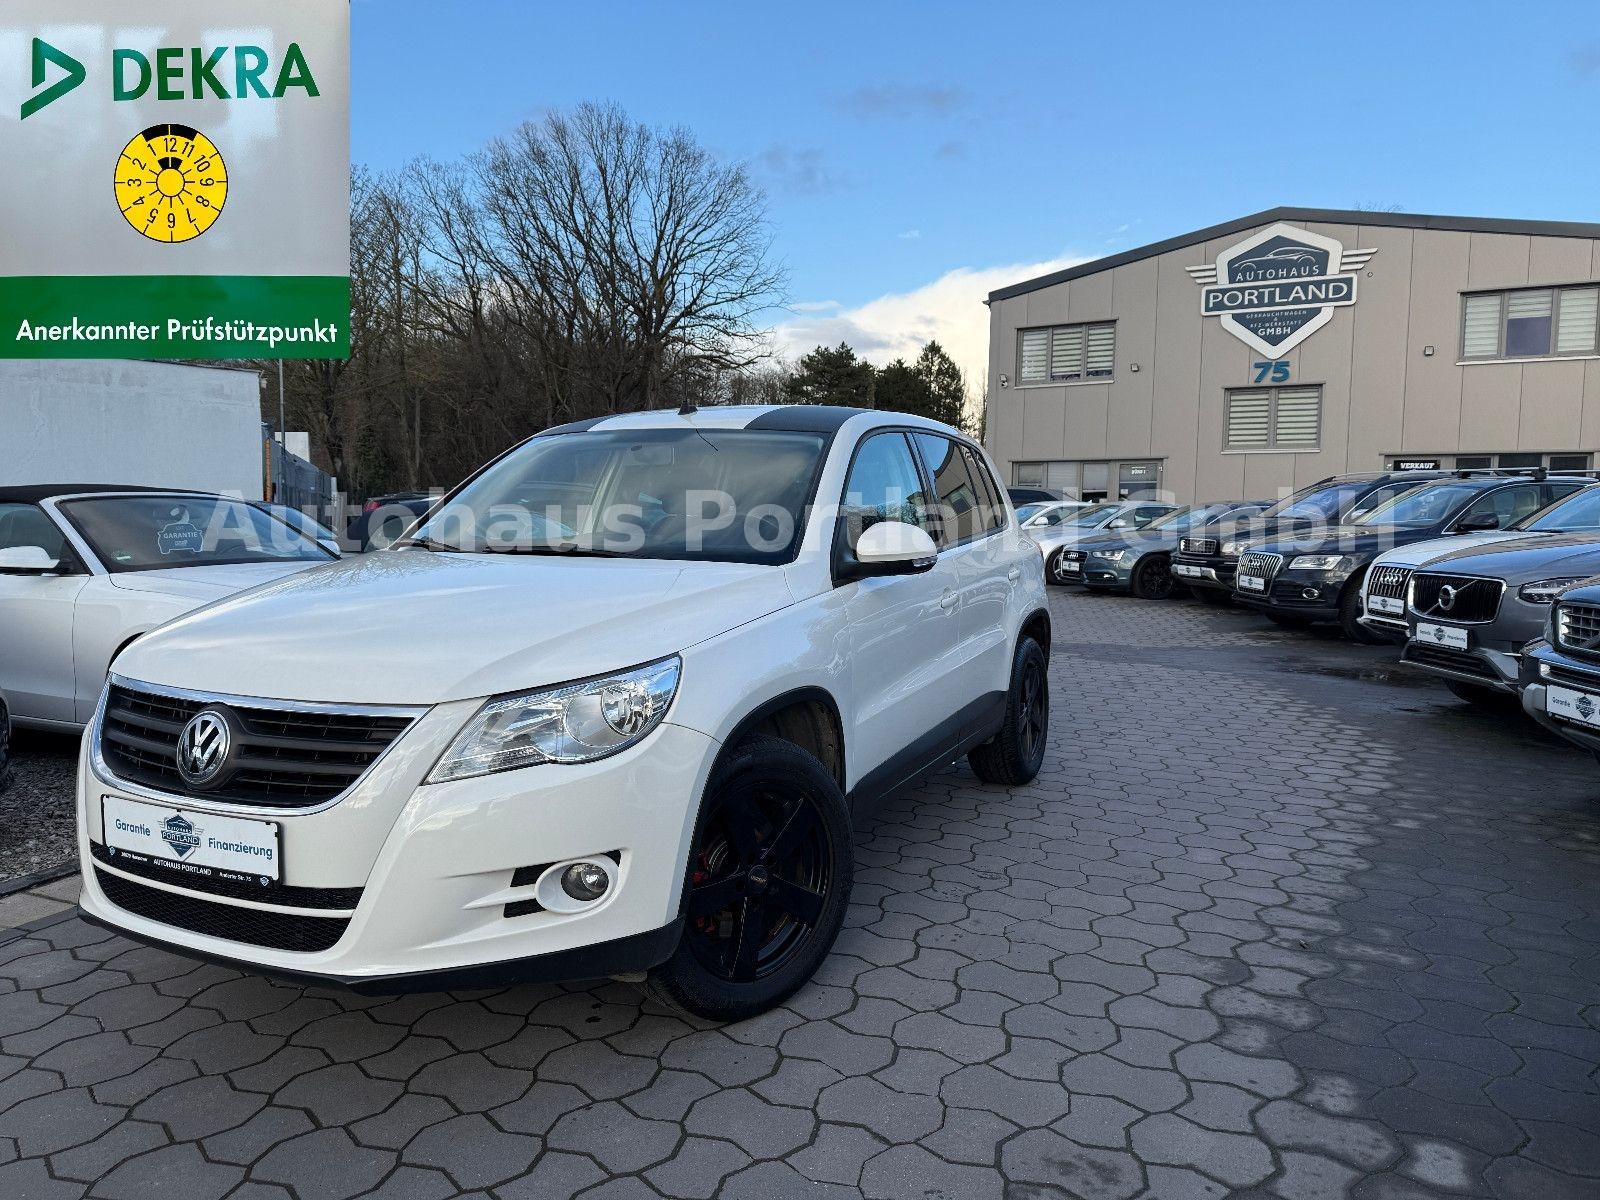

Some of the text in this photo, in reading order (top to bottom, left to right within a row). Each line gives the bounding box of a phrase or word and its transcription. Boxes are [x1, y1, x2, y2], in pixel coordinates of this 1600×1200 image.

[1235, 264, 1320, 282] AUTOHAUS
[1208, 282, 1348, 308] PORTLAND
[1258, 326, 1291, 336] GMBH
[1253, 360, 1290, 384] 75
[163, 531, 198, 539] GARANTIE
[115, 818, 151, 837] Garantie
[162, 831, 200, 845] PORTLAND
[208, 837, 273, 860] Finanzierung
[153, 859, 212, 876] AUTOHAUS PORTLAND
